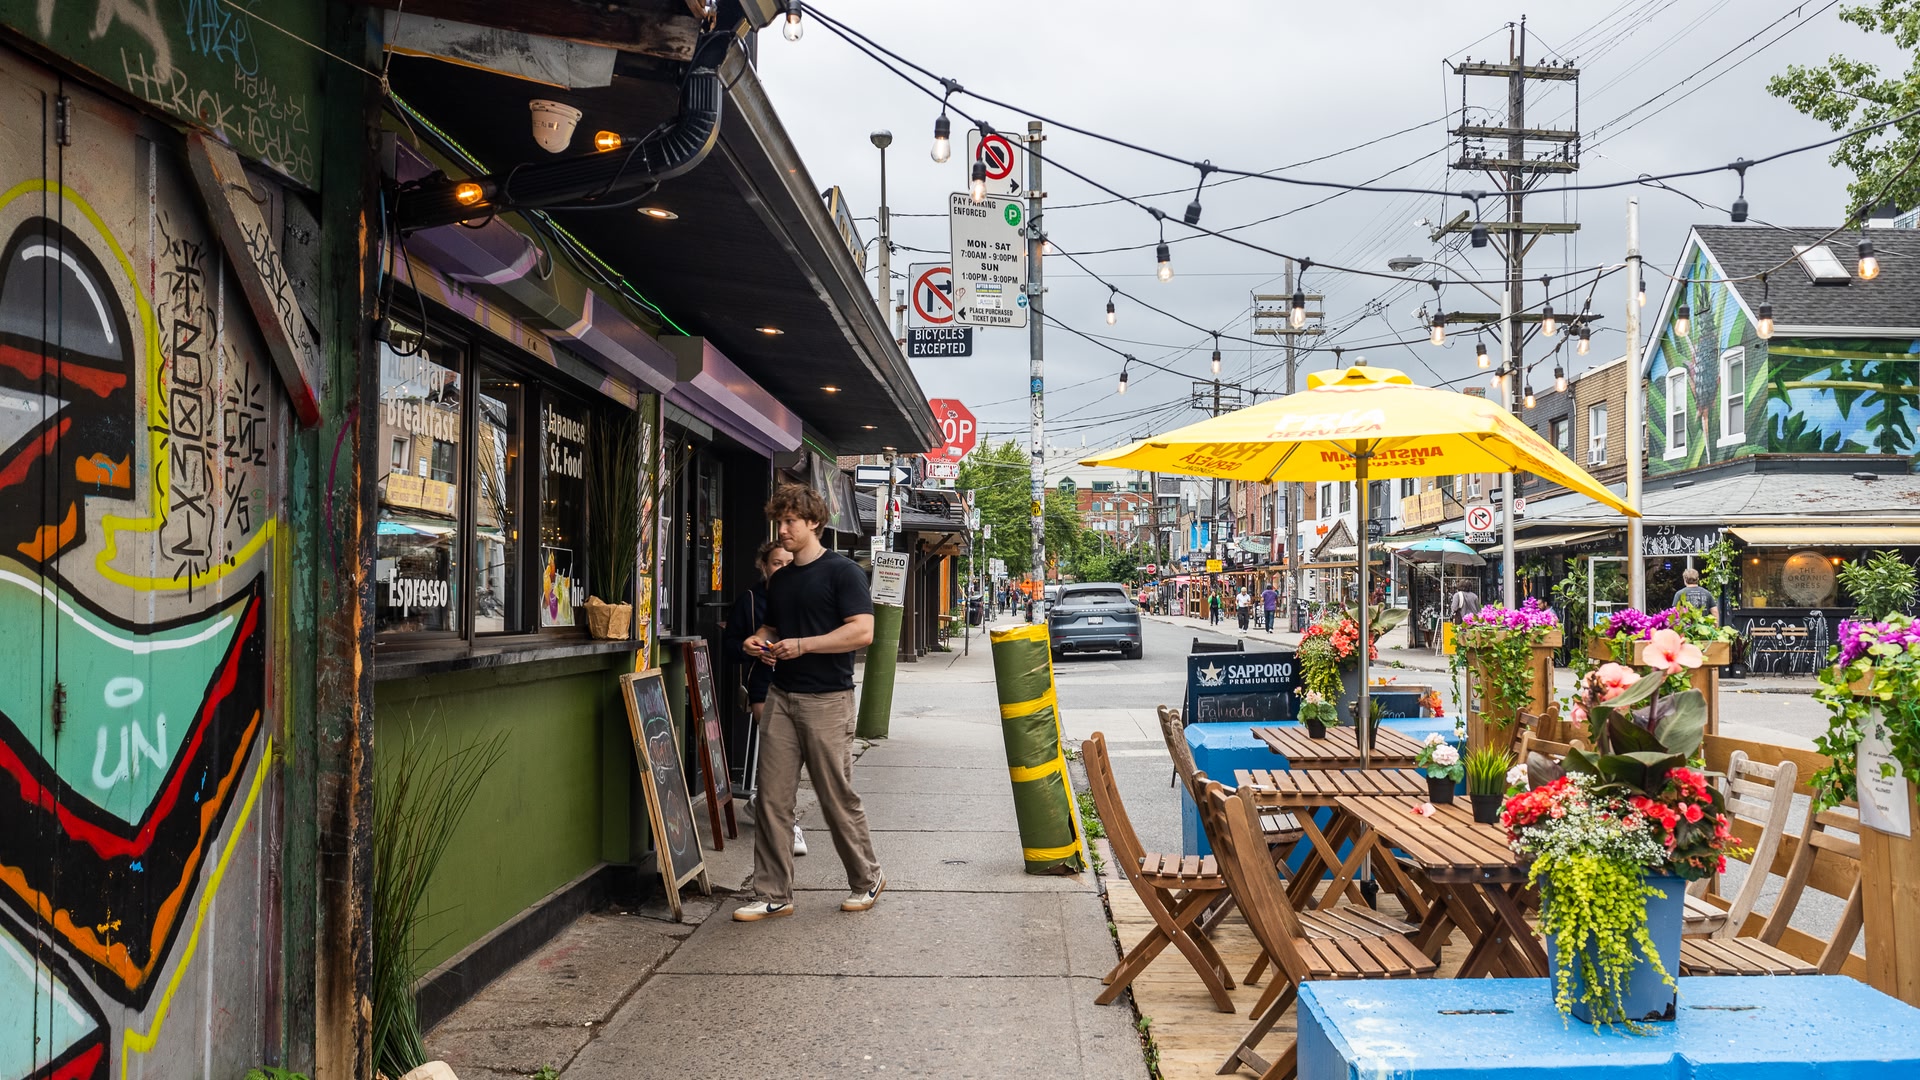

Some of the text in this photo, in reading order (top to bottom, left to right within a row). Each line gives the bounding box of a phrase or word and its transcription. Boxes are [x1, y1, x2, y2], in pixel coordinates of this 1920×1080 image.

[953, 197, 966, 205] PAY
[954, 207, 986, 217] ENFORCED
[967, 240, 987, 249] MON
[995, 242, 1011, 251] SAT
[961, 250, 987, 259] 7:00AM
[993, 253, 1018, 262] 9:00PM
[981, 263, 999, 271] SUN
[962, 272, 987, 281] 1:00PM
[993, 275, 1018, 284] 9:00PM
[985, 308, 1013, 316] PURCHASED
[915, 329, 964, 340] BICYCLES
[913, 342, 966, 355] EXCEPTED
[421, 349, 446, 402] Day
[387, 386, 455, 443] Breakfast
[548, 403, 585, 444] Japanese
[1267, 424, 1382, 438] CERVEZA
[550, 442, 583, 479] St. Food
[1656, 525, 1676, 535] 257
[389, 568, 448, 617] Espresso
[1228, 663, 1292, 679] SAPPORO
